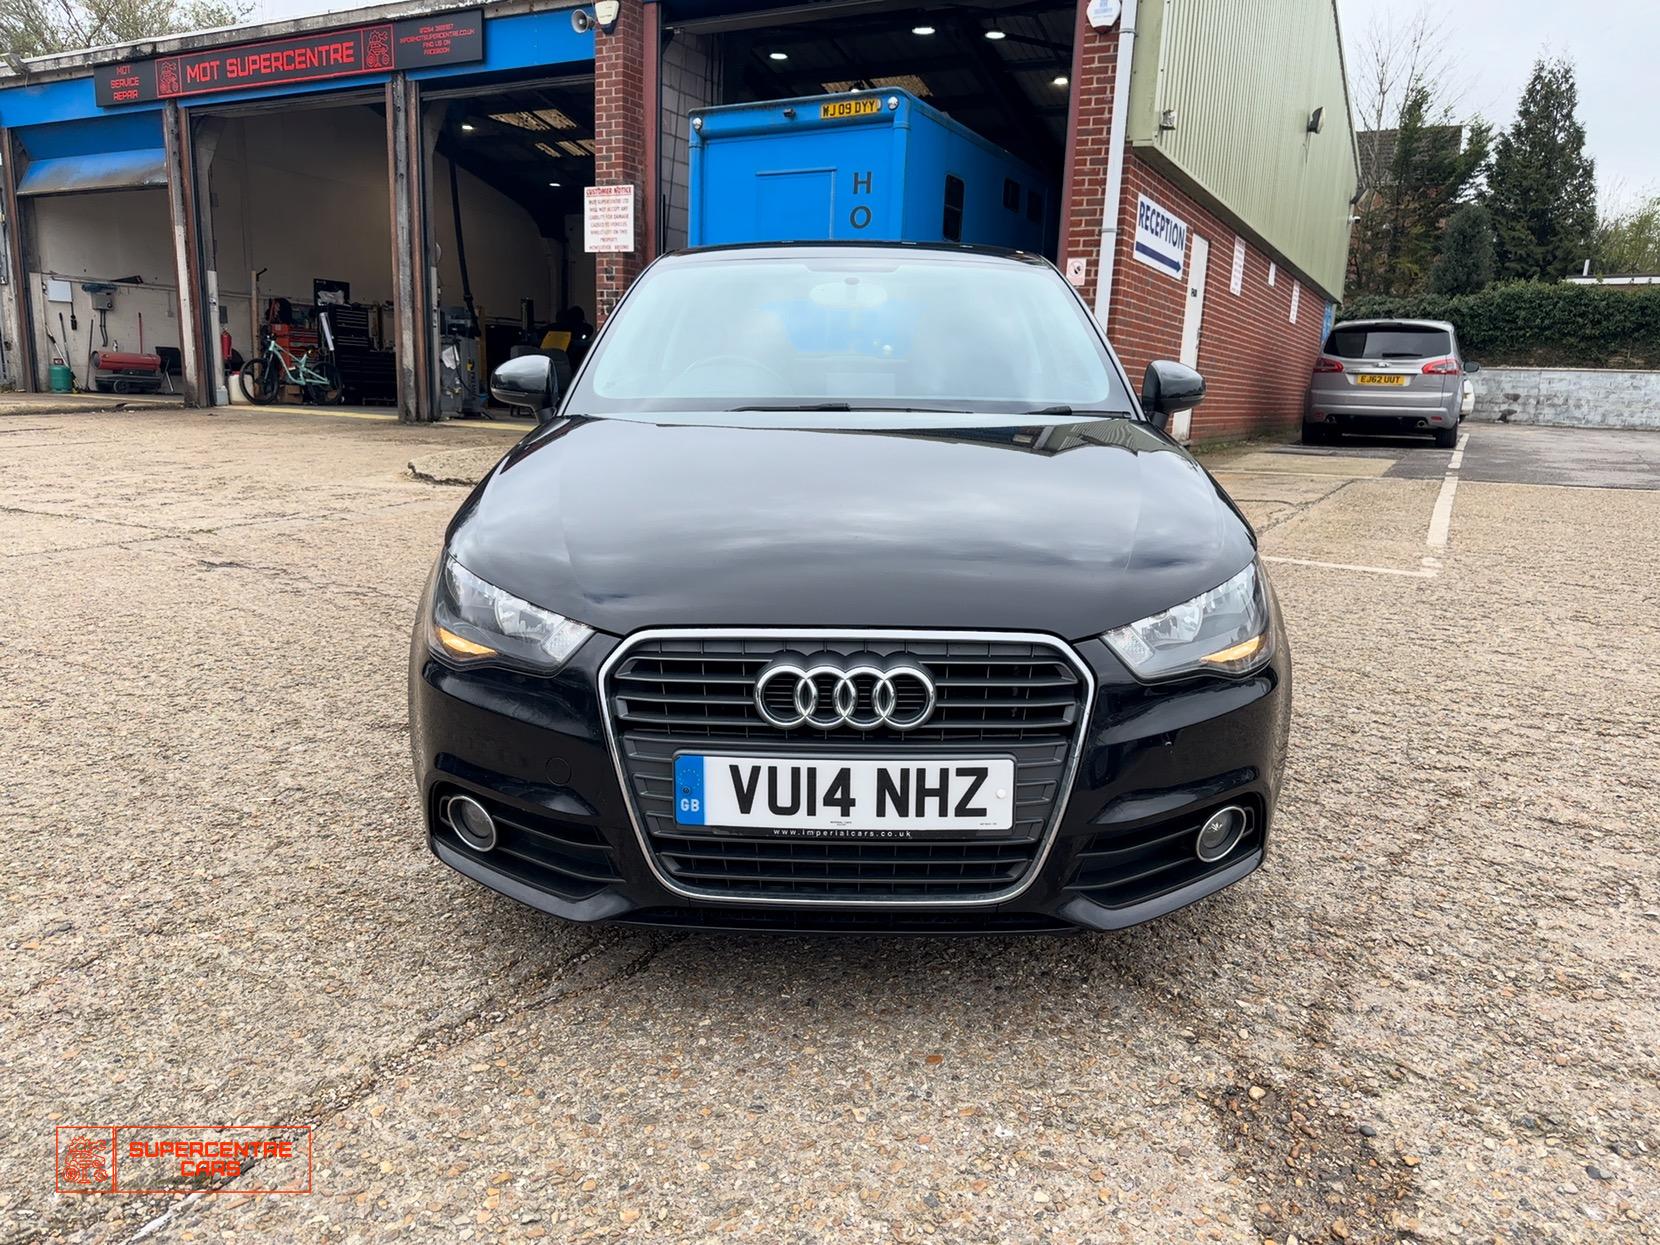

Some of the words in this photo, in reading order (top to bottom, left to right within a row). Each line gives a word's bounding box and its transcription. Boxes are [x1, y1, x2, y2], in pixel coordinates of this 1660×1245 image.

[186, 60, 220, 84] MOT
[226, 41, 355, 79] SUPERCENTRE
[116, 65, 131, 74] MOT
[111, 76, 140, 89] SERVICE
[113, 89, 139, 101] REPAIR
[838, 103, 852, 116] 09
[854, 99, 875, 114] DYY
[586, 187, 612, 195] CUSTOMER
[614, 186, 632, 194] NOTICE
[1138, 201, 1185, 251] RECEPTION
[1360, 375, 1382, 383] EJ62
[729, 764, 856, 817] VU14
[876, 767, 988, 818] NHZ
[680, 798, 700, 813] GB
[773, 828, 912, 839] www.imperialcars.co.uk
